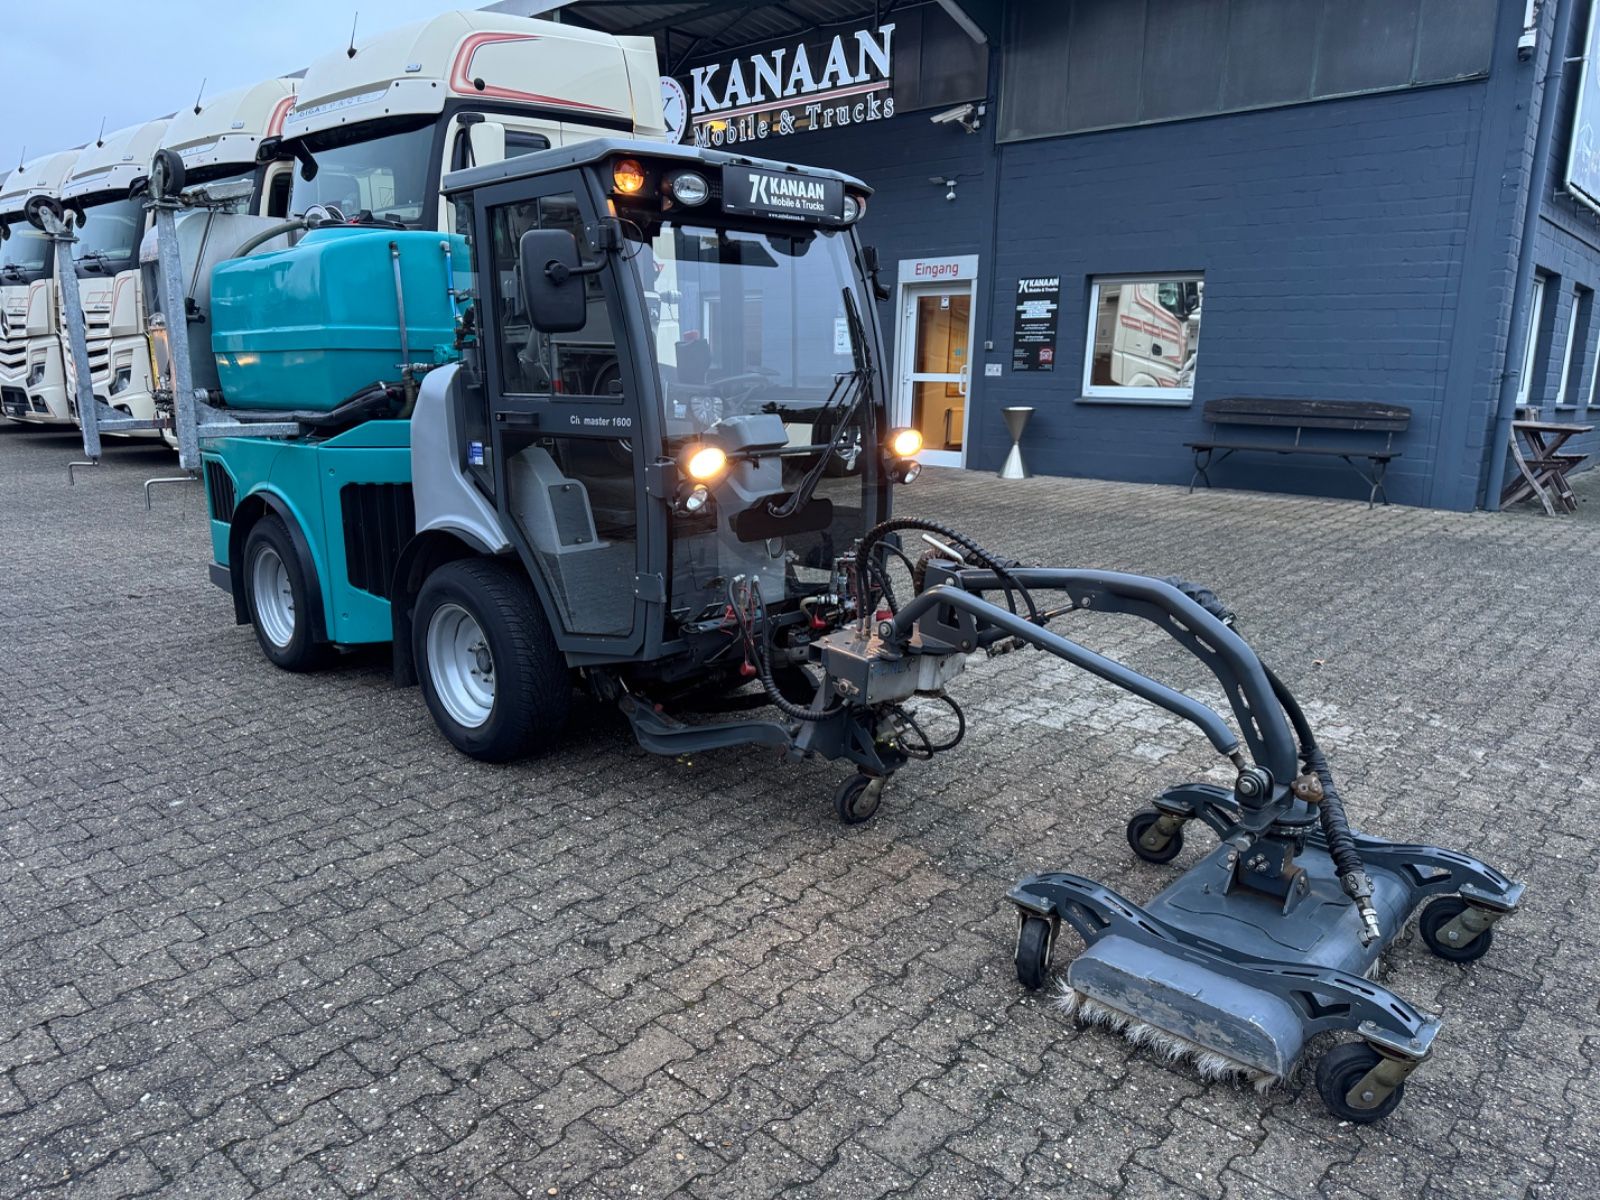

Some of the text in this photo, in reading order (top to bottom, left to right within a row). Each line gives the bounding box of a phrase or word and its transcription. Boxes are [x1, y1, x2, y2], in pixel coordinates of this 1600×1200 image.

[690, 23, 896, 114] KANAAN
[693, 92, 895, 148] Mobile & Trucks
[769, 177, 825, 200] KANAAN
[770, 196, 825, 211] Mobile & Trucks
[915, 263, 959, 278] Eingang
[1029, 278, 1059, 287] KANAAN
[583, 417, 610, 426] master
[612, 417, 632, 427] 1600
